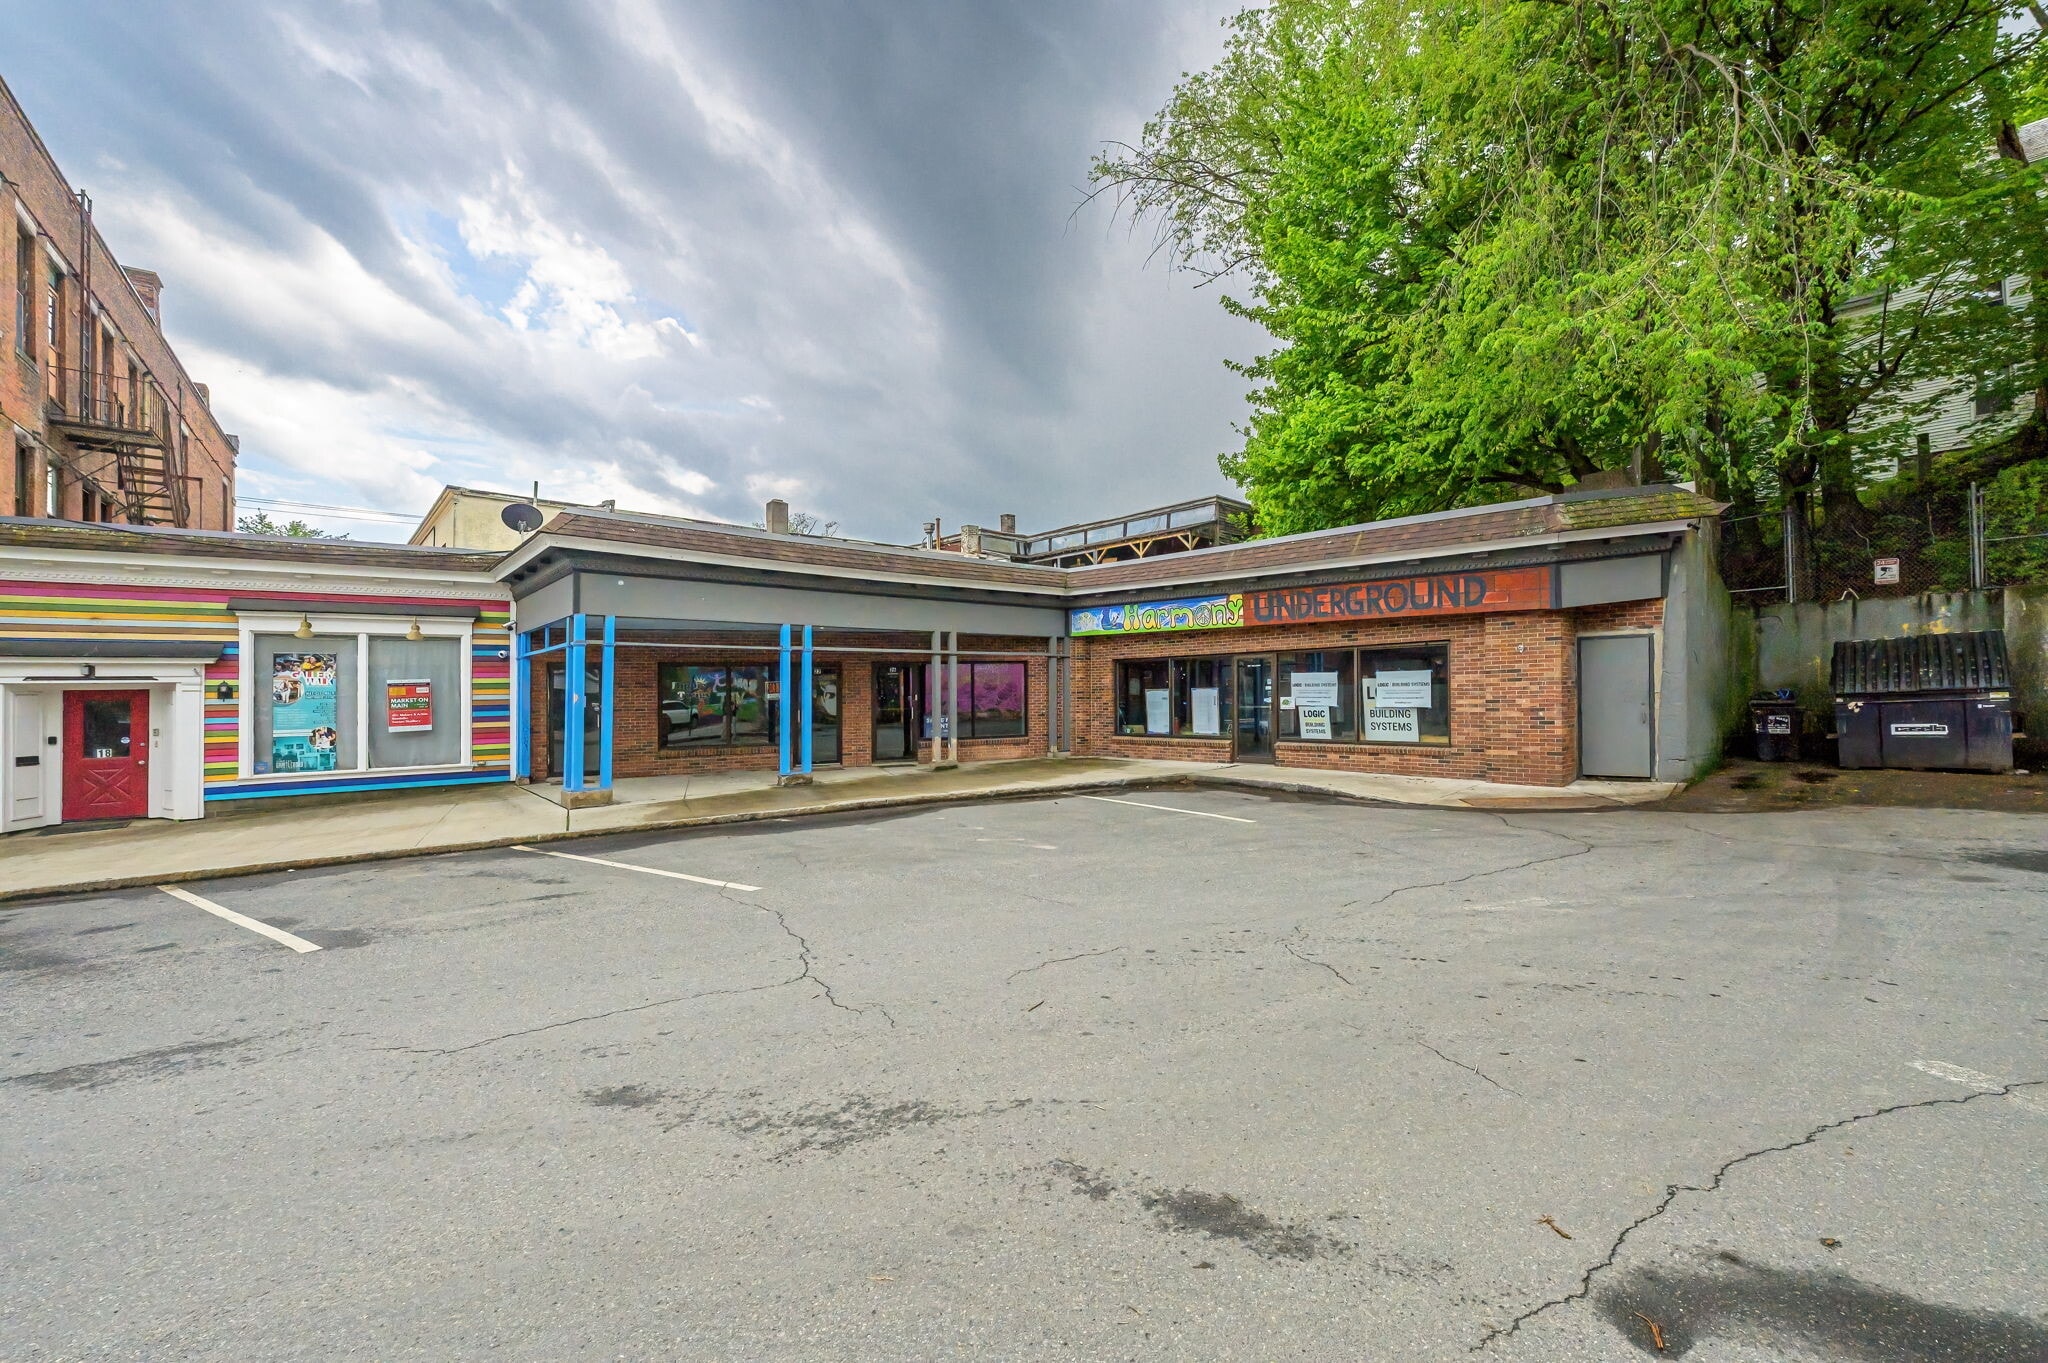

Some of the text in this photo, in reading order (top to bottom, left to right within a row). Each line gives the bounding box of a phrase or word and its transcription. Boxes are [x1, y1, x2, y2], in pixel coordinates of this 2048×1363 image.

[1253, 576, 1487, 622] UNDERGROUND
[1123, 599, 1243, 631] Harmony
[293, 669, 336, 678] GALLERY
[305, 677, 335, 686] WALK
[1303, 710, 1326, 718] LOGIC
[1370, 709, 1412, 719] BUILDING
[1370, 722, 1412, 732] SYSTEMS
[98, 749, 111, 757] 18
